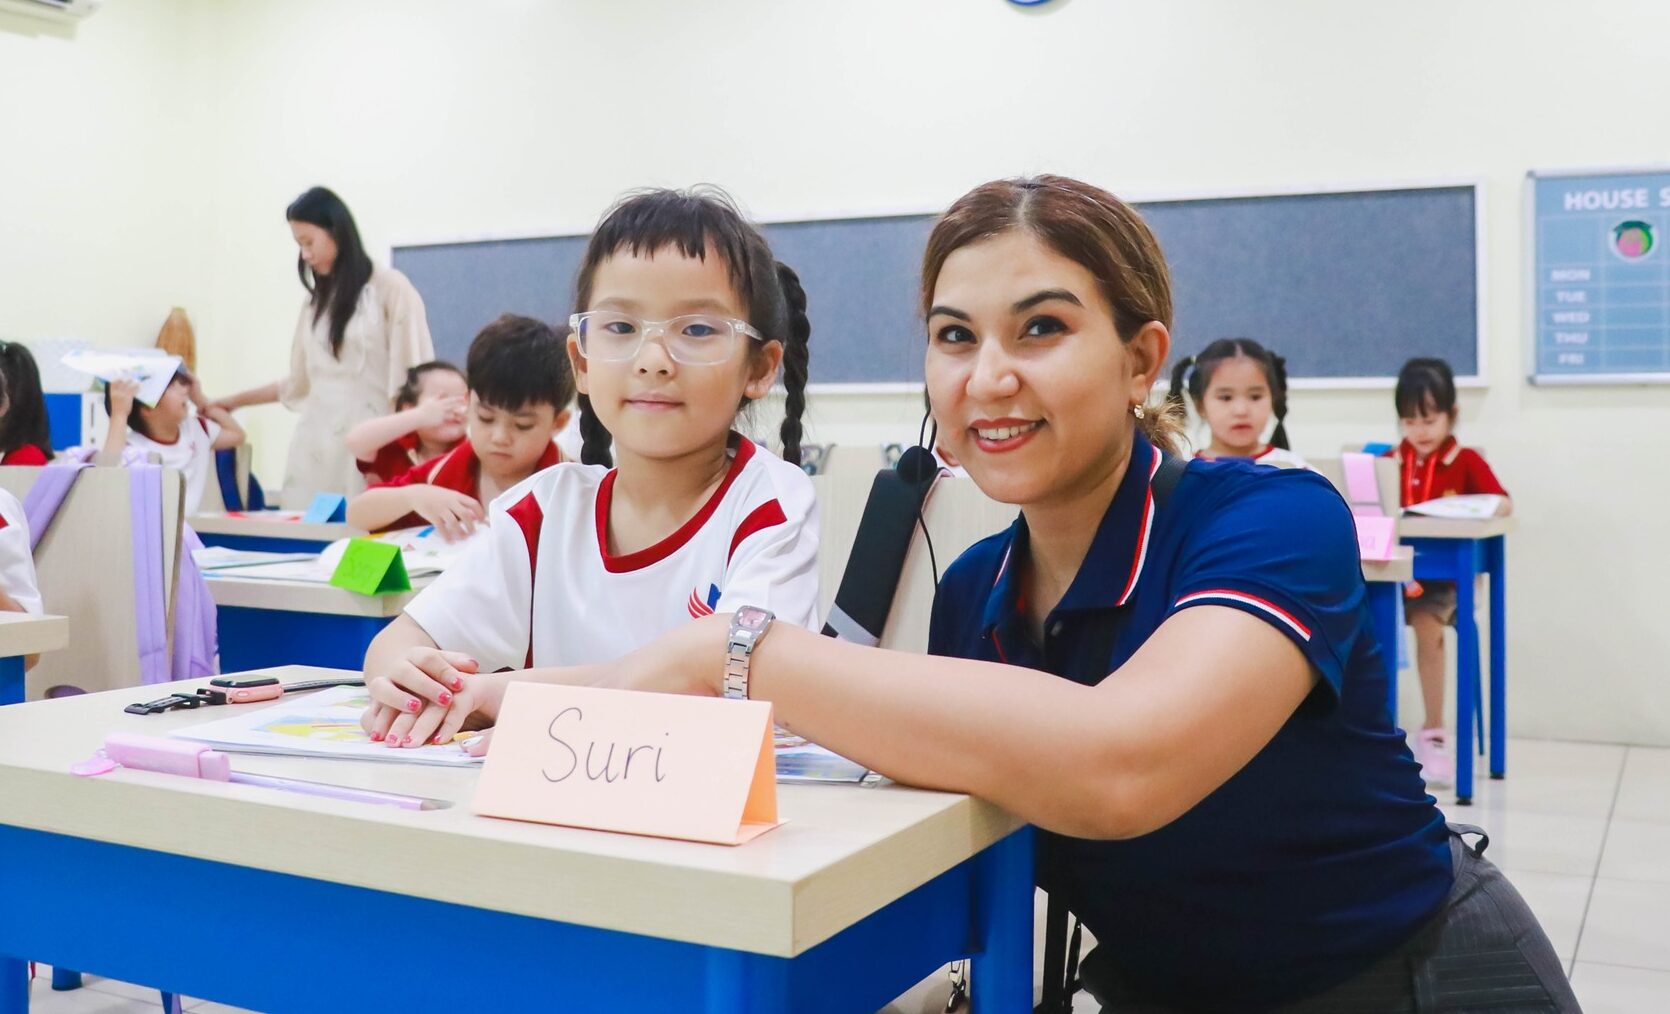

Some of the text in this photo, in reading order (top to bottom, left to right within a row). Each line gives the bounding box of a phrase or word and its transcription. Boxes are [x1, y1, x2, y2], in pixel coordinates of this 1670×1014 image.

[1564, 188, 1649, 210] HOUSE
[1550, 269, 1591, 281] MON
[1555, 290, 1587, 303] TUE
[1552, 311, 1590, 323] WED
[1554, 332, 1588, 344] THU
[1558, 352, 1584, 365] FRI
[541, 706, 669, 783] Suri
